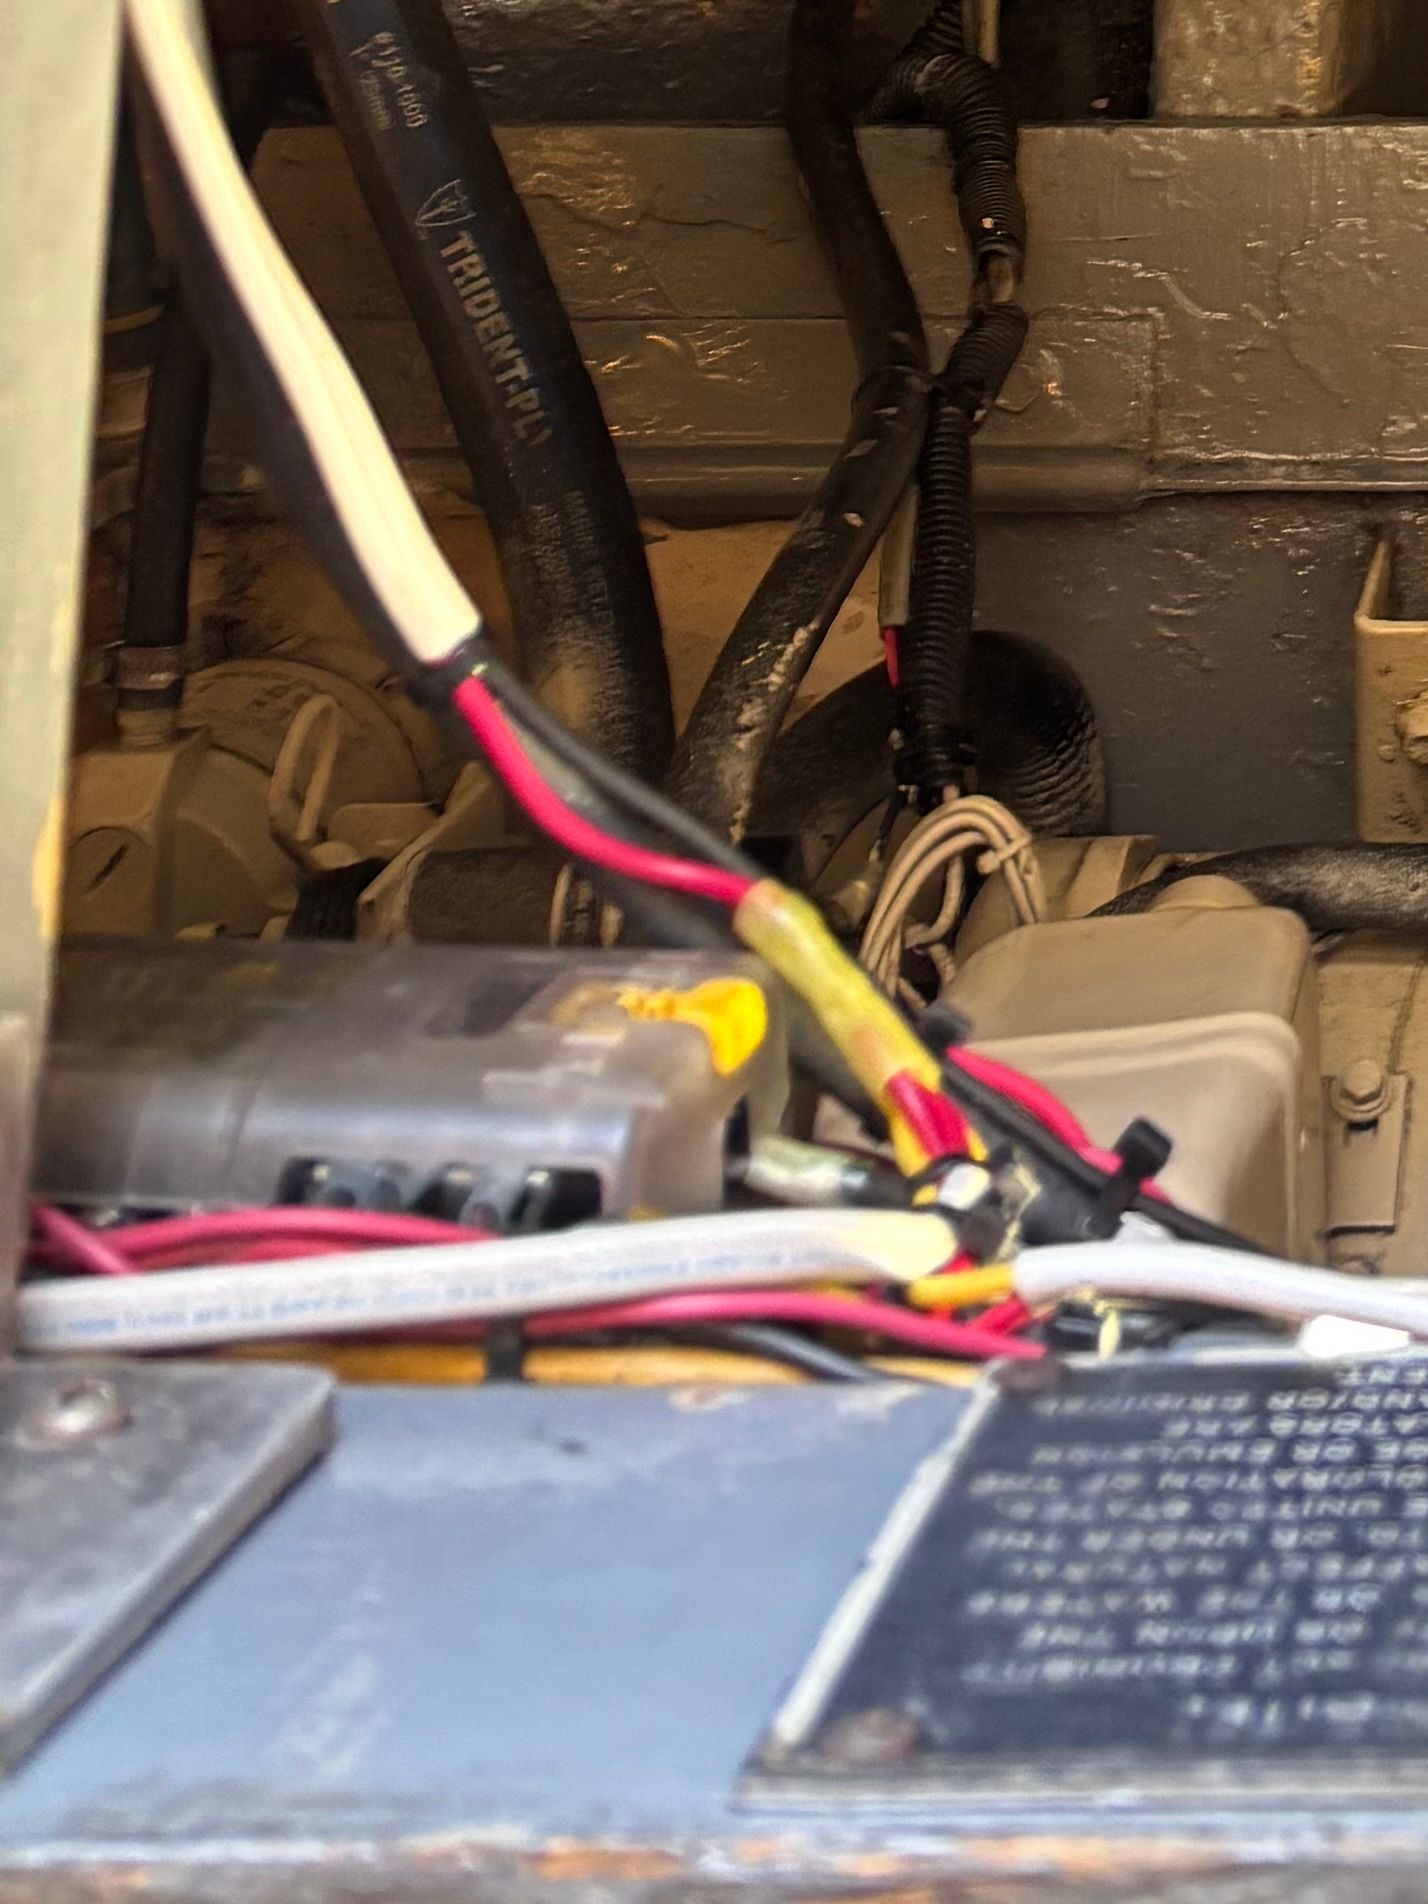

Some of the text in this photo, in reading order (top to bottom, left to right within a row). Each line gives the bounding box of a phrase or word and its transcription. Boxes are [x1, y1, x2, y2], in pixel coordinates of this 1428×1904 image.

[1032, 1392, 1250, 1414] CRIMINAL
[1161, 1417, 1254, 1437] ARE
[1082, 1525, 1250, 1550] UNDER
[963, 1589, 1176, 1615] WATERS
